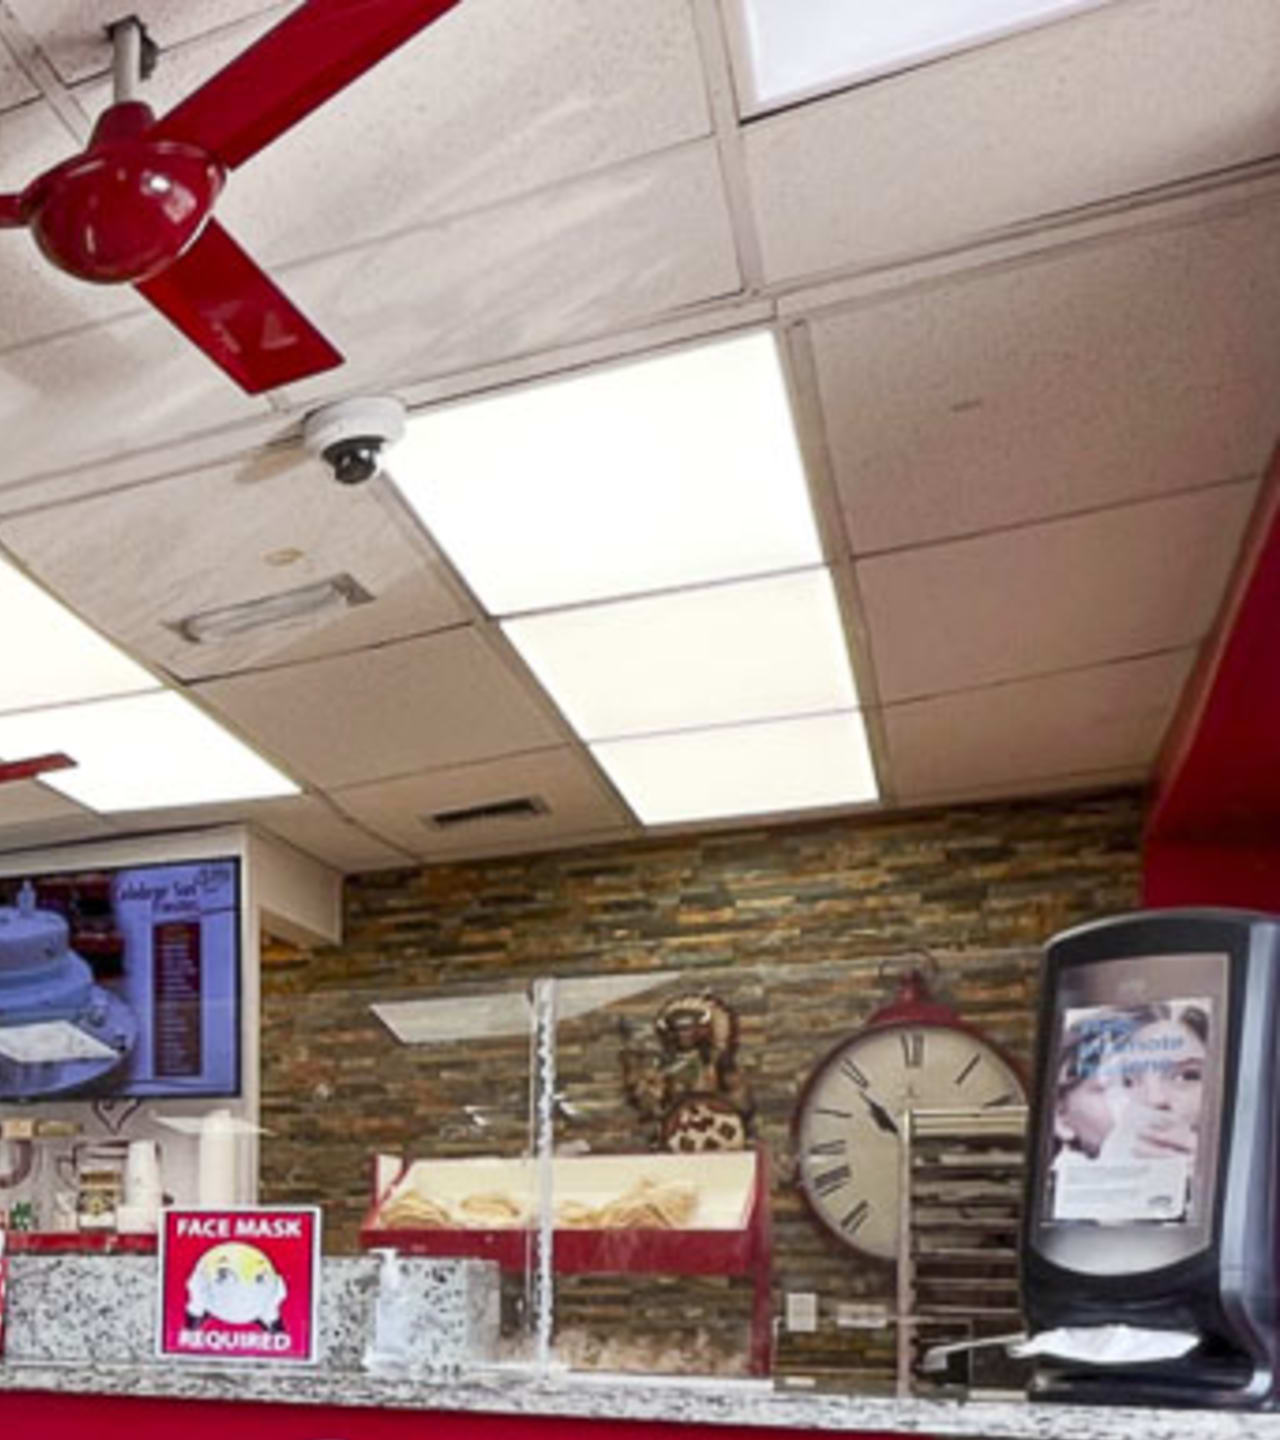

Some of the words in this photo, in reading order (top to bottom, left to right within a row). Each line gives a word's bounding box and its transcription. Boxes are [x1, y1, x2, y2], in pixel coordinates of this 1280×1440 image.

[176, 1217, 230, 1238] FACE
[234, 1217, 303, 1238] MASK
[176, 1329, 293, 1351] REQUIRED
